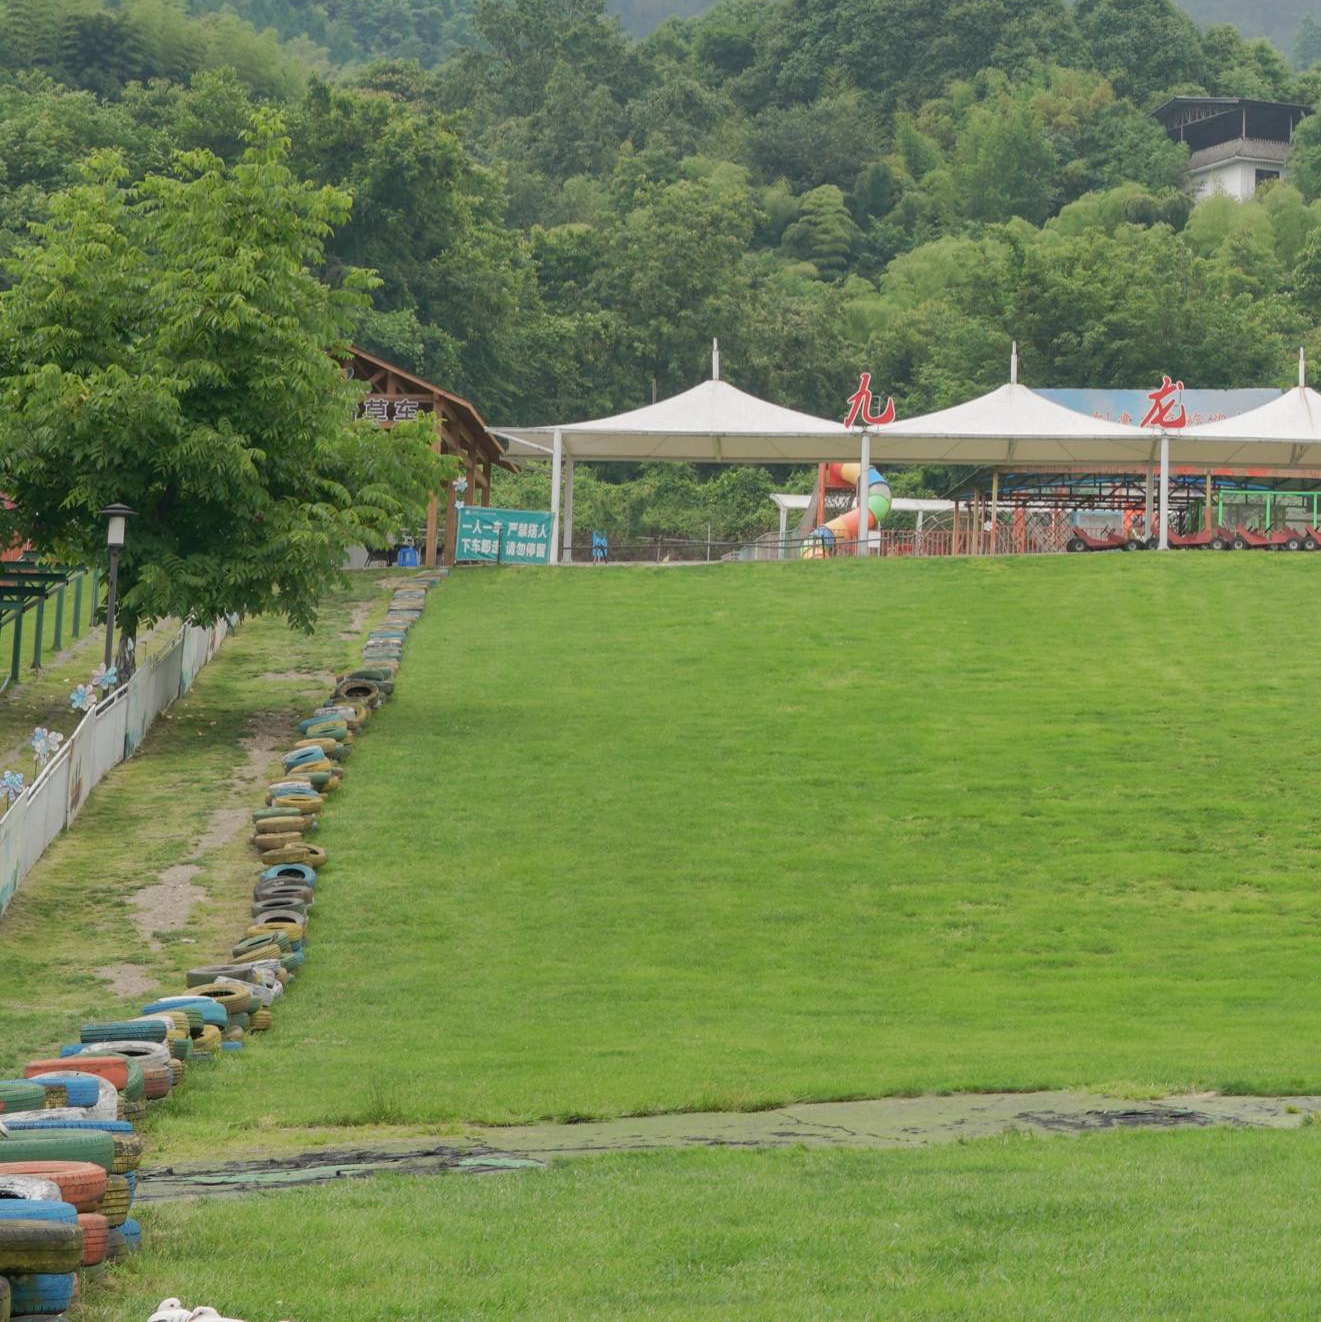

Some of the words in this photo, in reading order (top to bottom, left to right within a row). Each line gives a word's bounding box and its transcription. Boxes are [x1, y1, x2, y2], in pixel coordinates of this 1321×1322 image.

[353, 398, 418, 422] 草车
[844, 372, 895, 429] 九
[1140, 375, 1186, 428] 龙
[462, 519, 503, 535] 一人一车
[506, 541, 546, 558] 请勿停留
